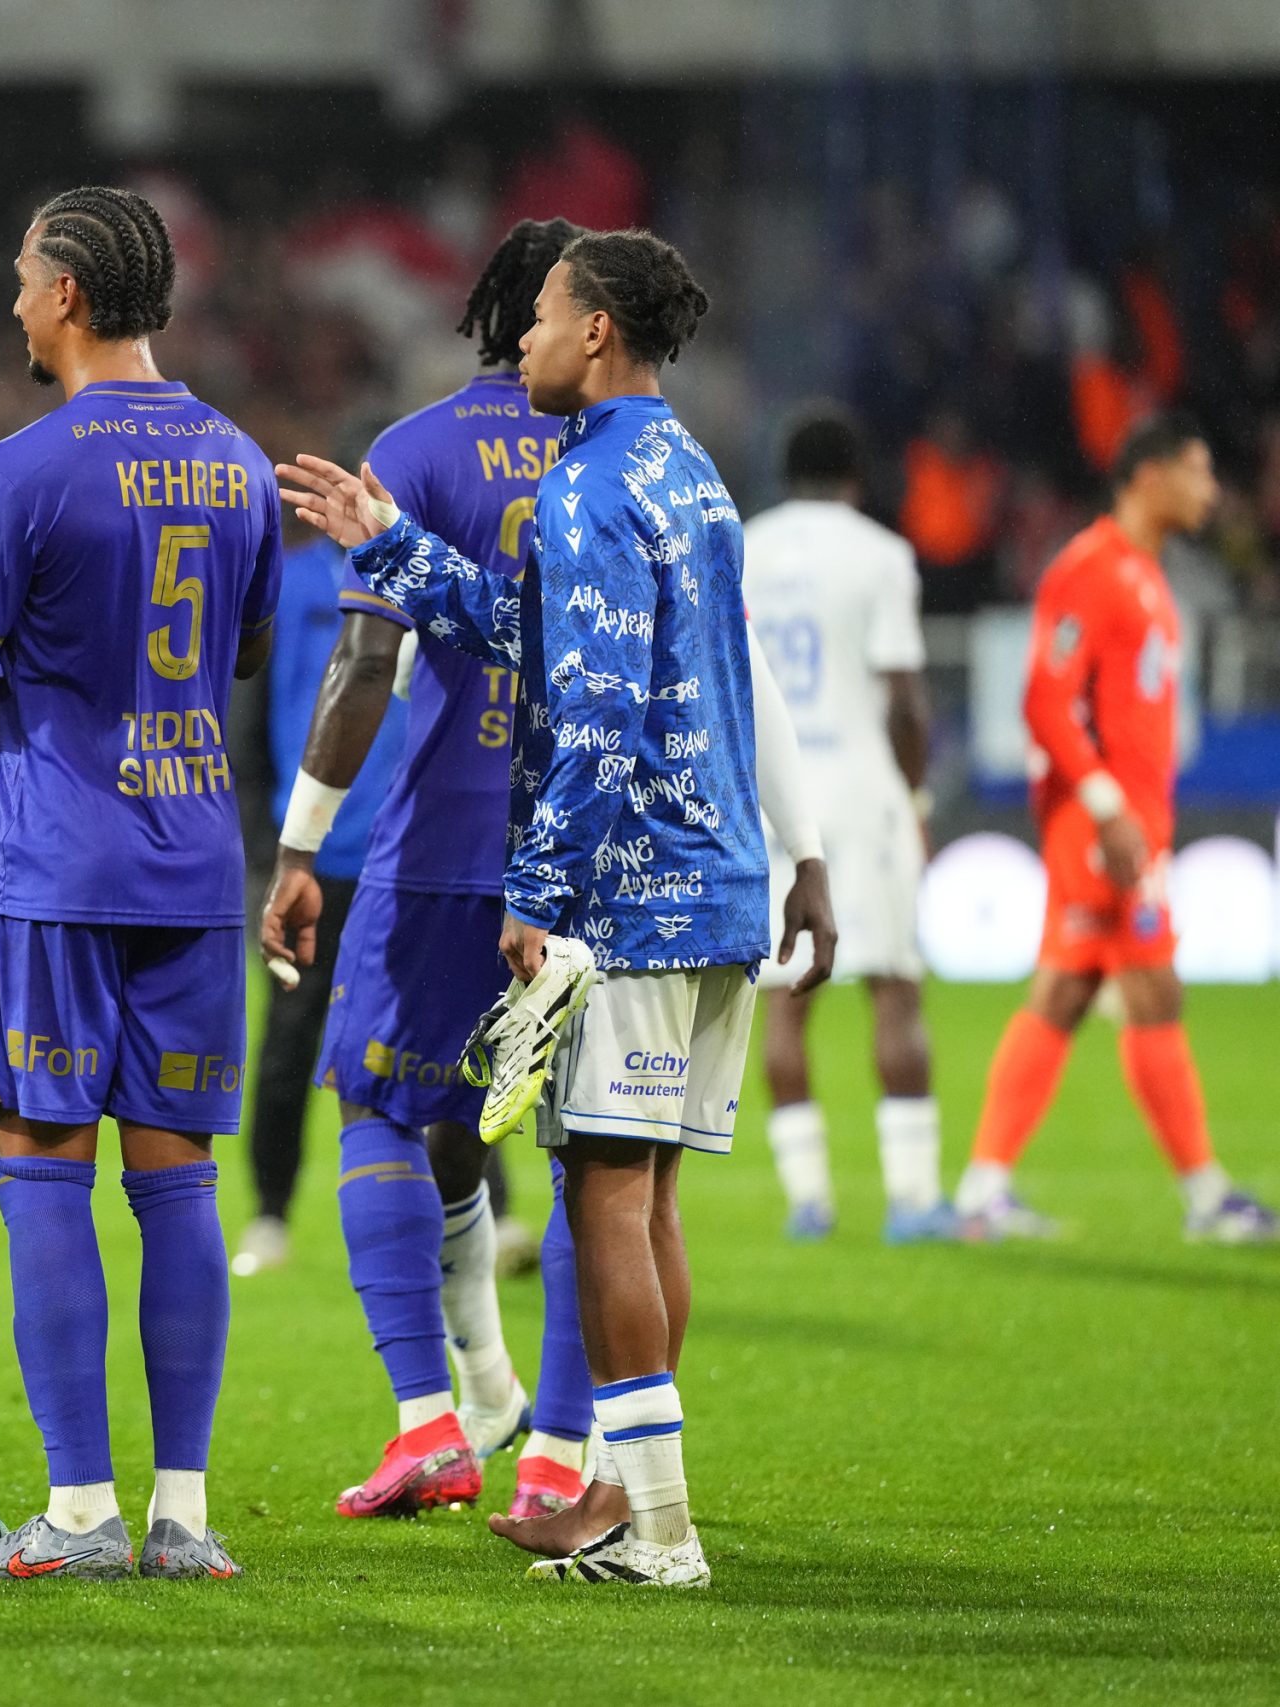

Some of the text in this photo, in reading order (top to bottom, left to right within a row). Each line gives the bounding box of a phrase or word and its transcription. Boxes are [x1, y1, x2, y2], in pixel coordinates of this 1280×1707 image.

[454, 403, 519, 419] BANG
[71, 419, 244, 442] BANG & OLUFSEN
[115, 459, 249, 510] KEHRER
[669, 486, 694, 508] AJ
[147, 525, 210, 681] 5
[122, 708, 223, 752] TEDDY
[557, 722, 622, 752] BLANC
[665, 729, 709, 759] BLANC
[117, 752, 231, 798] SMITH
[627, 767, 695, 814] YONNE
[624, 1050, 690, 1077] Cichy
